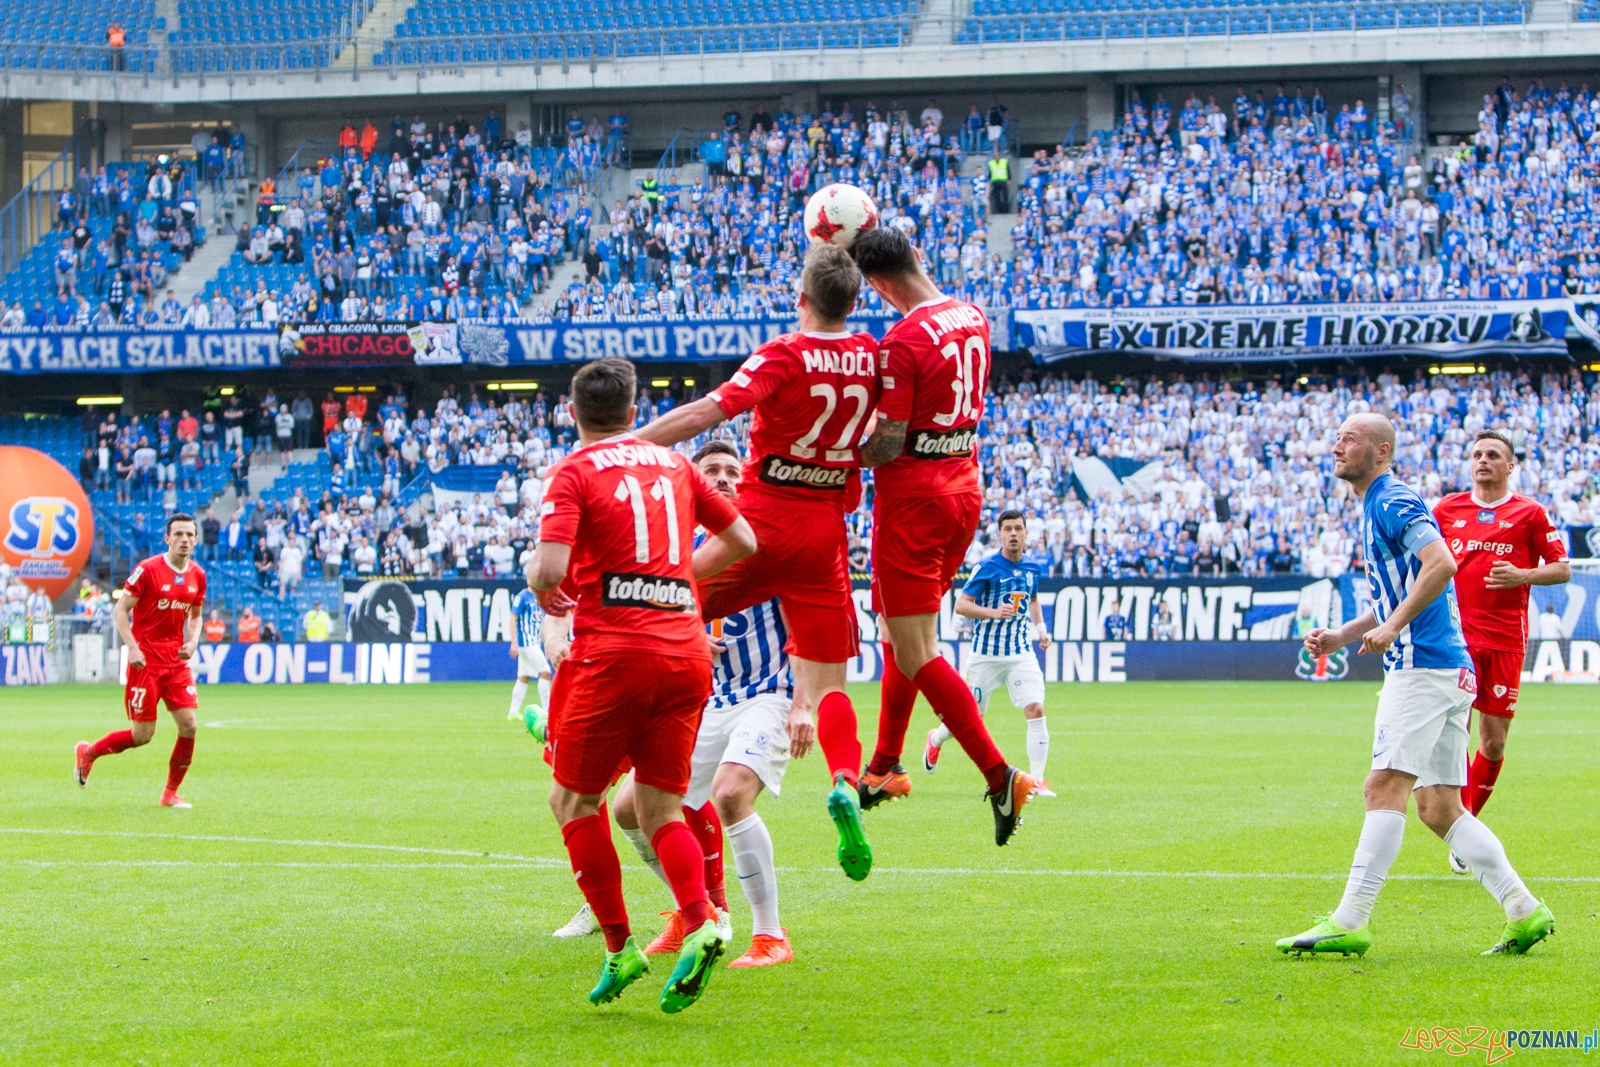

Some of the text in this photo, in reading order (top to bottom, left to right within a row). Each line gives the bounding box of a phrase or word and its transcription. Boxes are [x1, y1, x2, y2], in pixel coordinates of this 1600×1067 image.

[299, 324, 407, 334] ARKA CRACOVIA LECH
[303, 335, 412, 355] CHICAGO
[516, 330, 557, 360] W
[563, 326, 667, 360] SERCU
[125, 333, 281, 368] SZLACHET
[789, 382, 869, 462] 22
[913, 429, 976, 454] totolote
[3, 496, 81, 557] STS
[614, 474, 680, 566] 11
[1466, 540, 1513, 556] Energa
[243, 643, 432, 685] ON-LINE
[131, 687, 146, 708] 27
